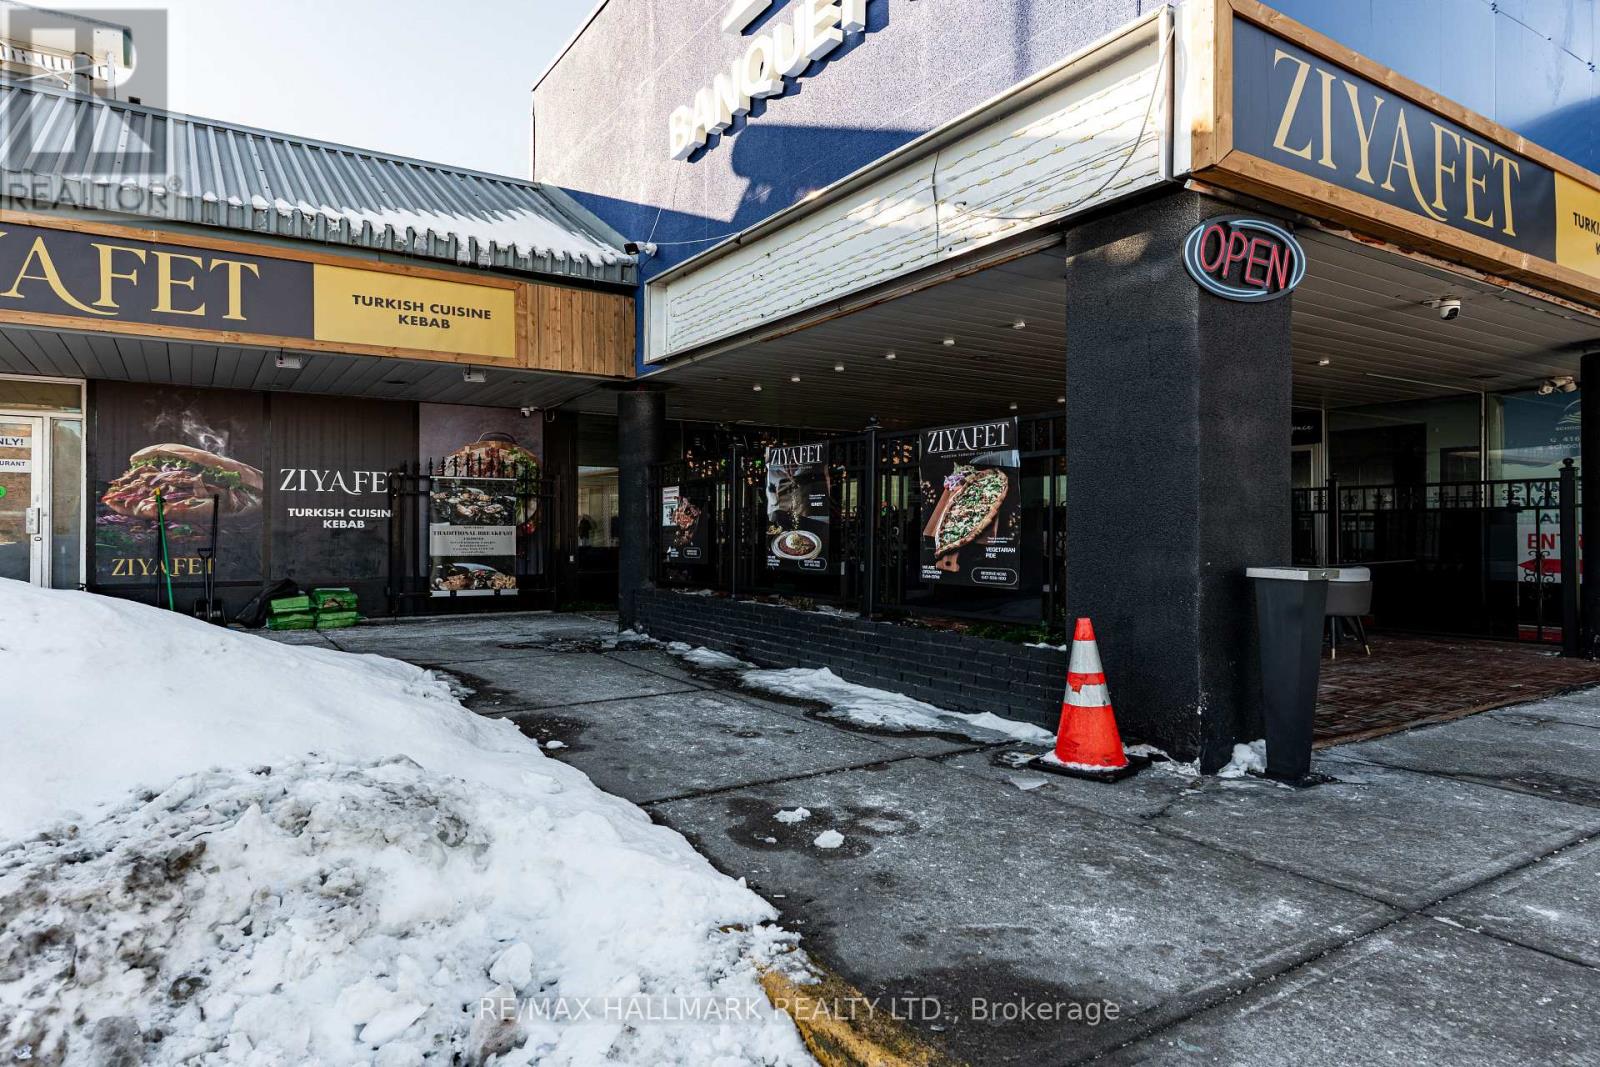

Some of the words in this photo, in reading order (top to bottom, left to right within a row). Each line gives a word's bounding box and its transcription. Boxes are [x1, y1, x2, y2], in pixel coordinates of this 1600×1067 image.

[1273, 49, 1521, 238] ZIYAFET
[1572, 211, 1600, 236] TURKI
[1200, 223, 1290, 289] OPEN
[0, 231, 261, 321] AFET
[352, 294, 425, 313] TURKISH
[429, 303, 492, 320] CUISINE
[398, 314, 451, 329] KEBAB
[928, 423, 1010, 453] ZIYAFET
[770, 444, 823, 466] ZIYAFET
[287, 507, 345, 517] TURKISH
[348, 508, 392, 518] CUISIN
[322, 519, 366, 529] KEBAB
